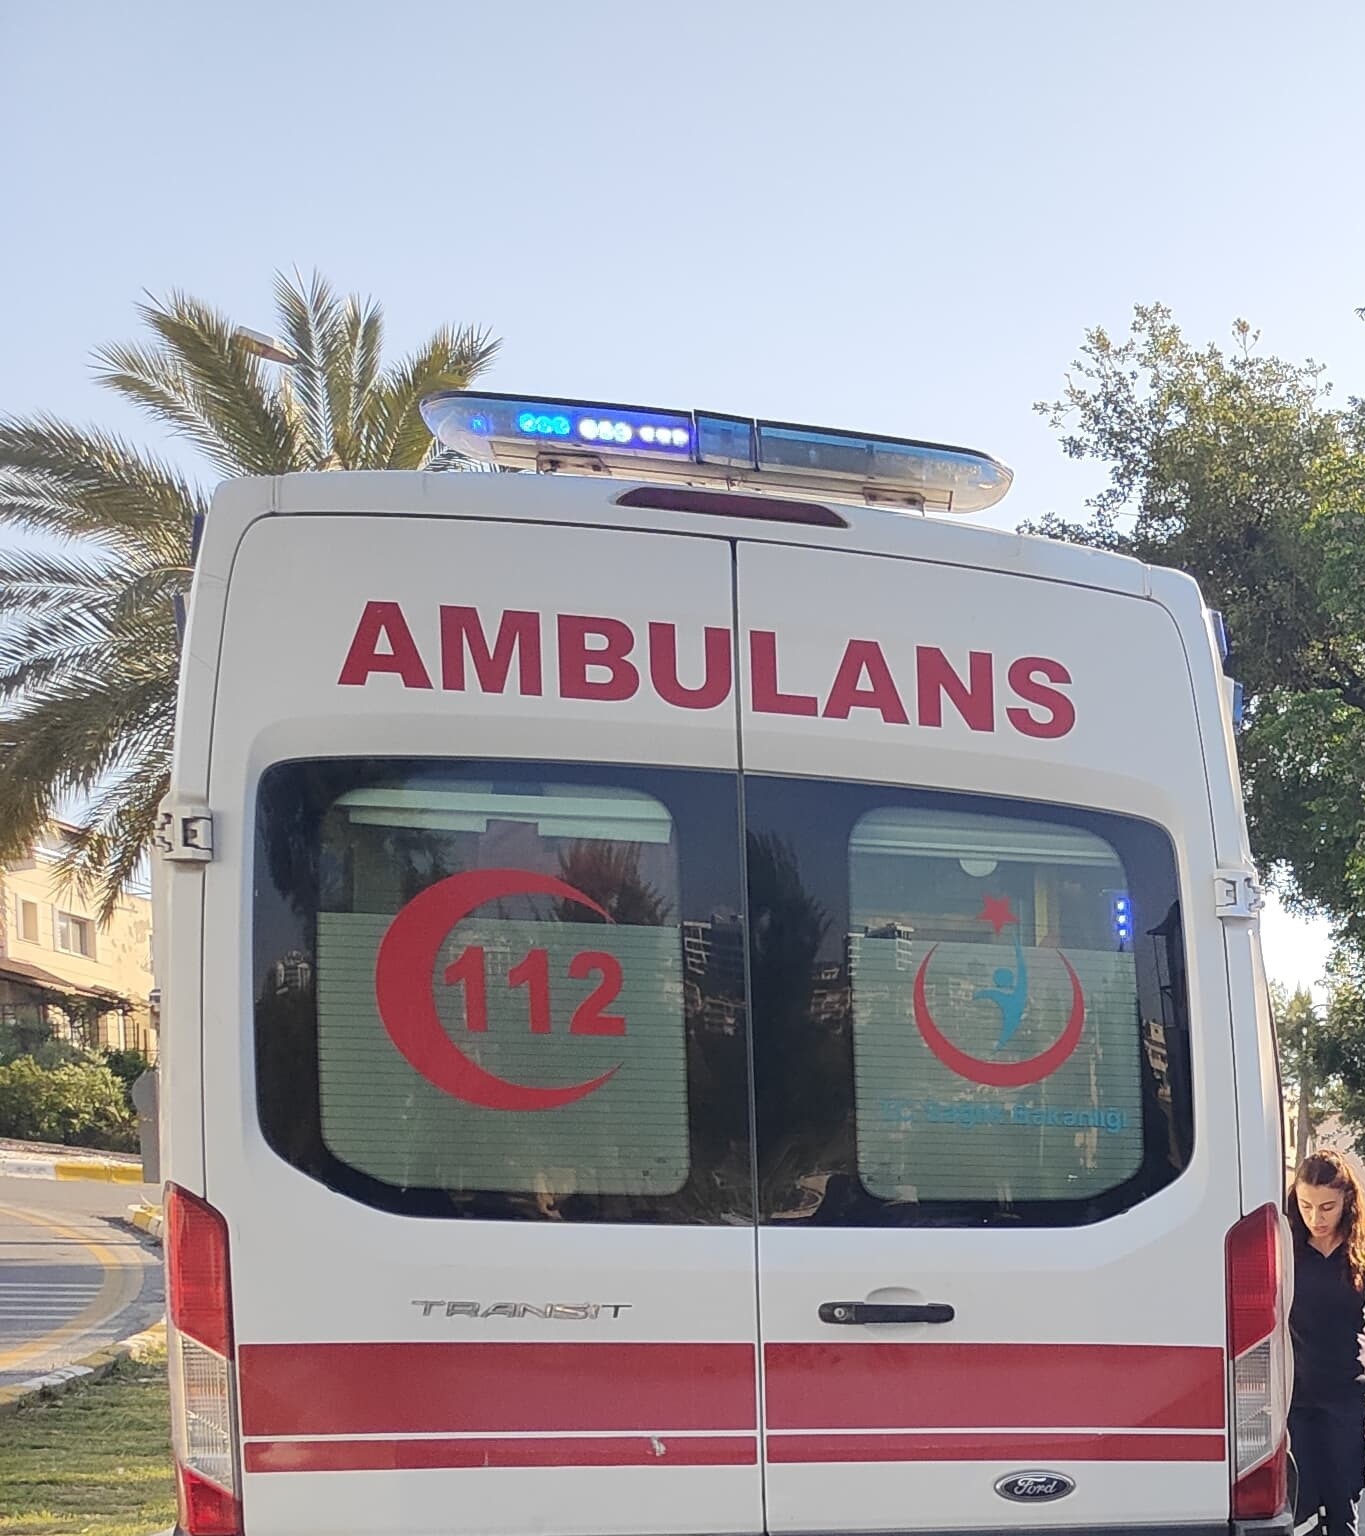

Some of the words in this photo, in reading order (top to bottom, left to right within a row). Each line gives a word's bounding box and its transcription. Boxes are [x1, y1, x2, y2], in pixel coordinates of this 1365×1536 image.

[337, 601, 1076, 739] AMBULANS
[444, 945, 627, 1036] 112
[411, 1299, 633, 1320] TRANSIT
[1014, 1477, 1058, 1495] Ford
